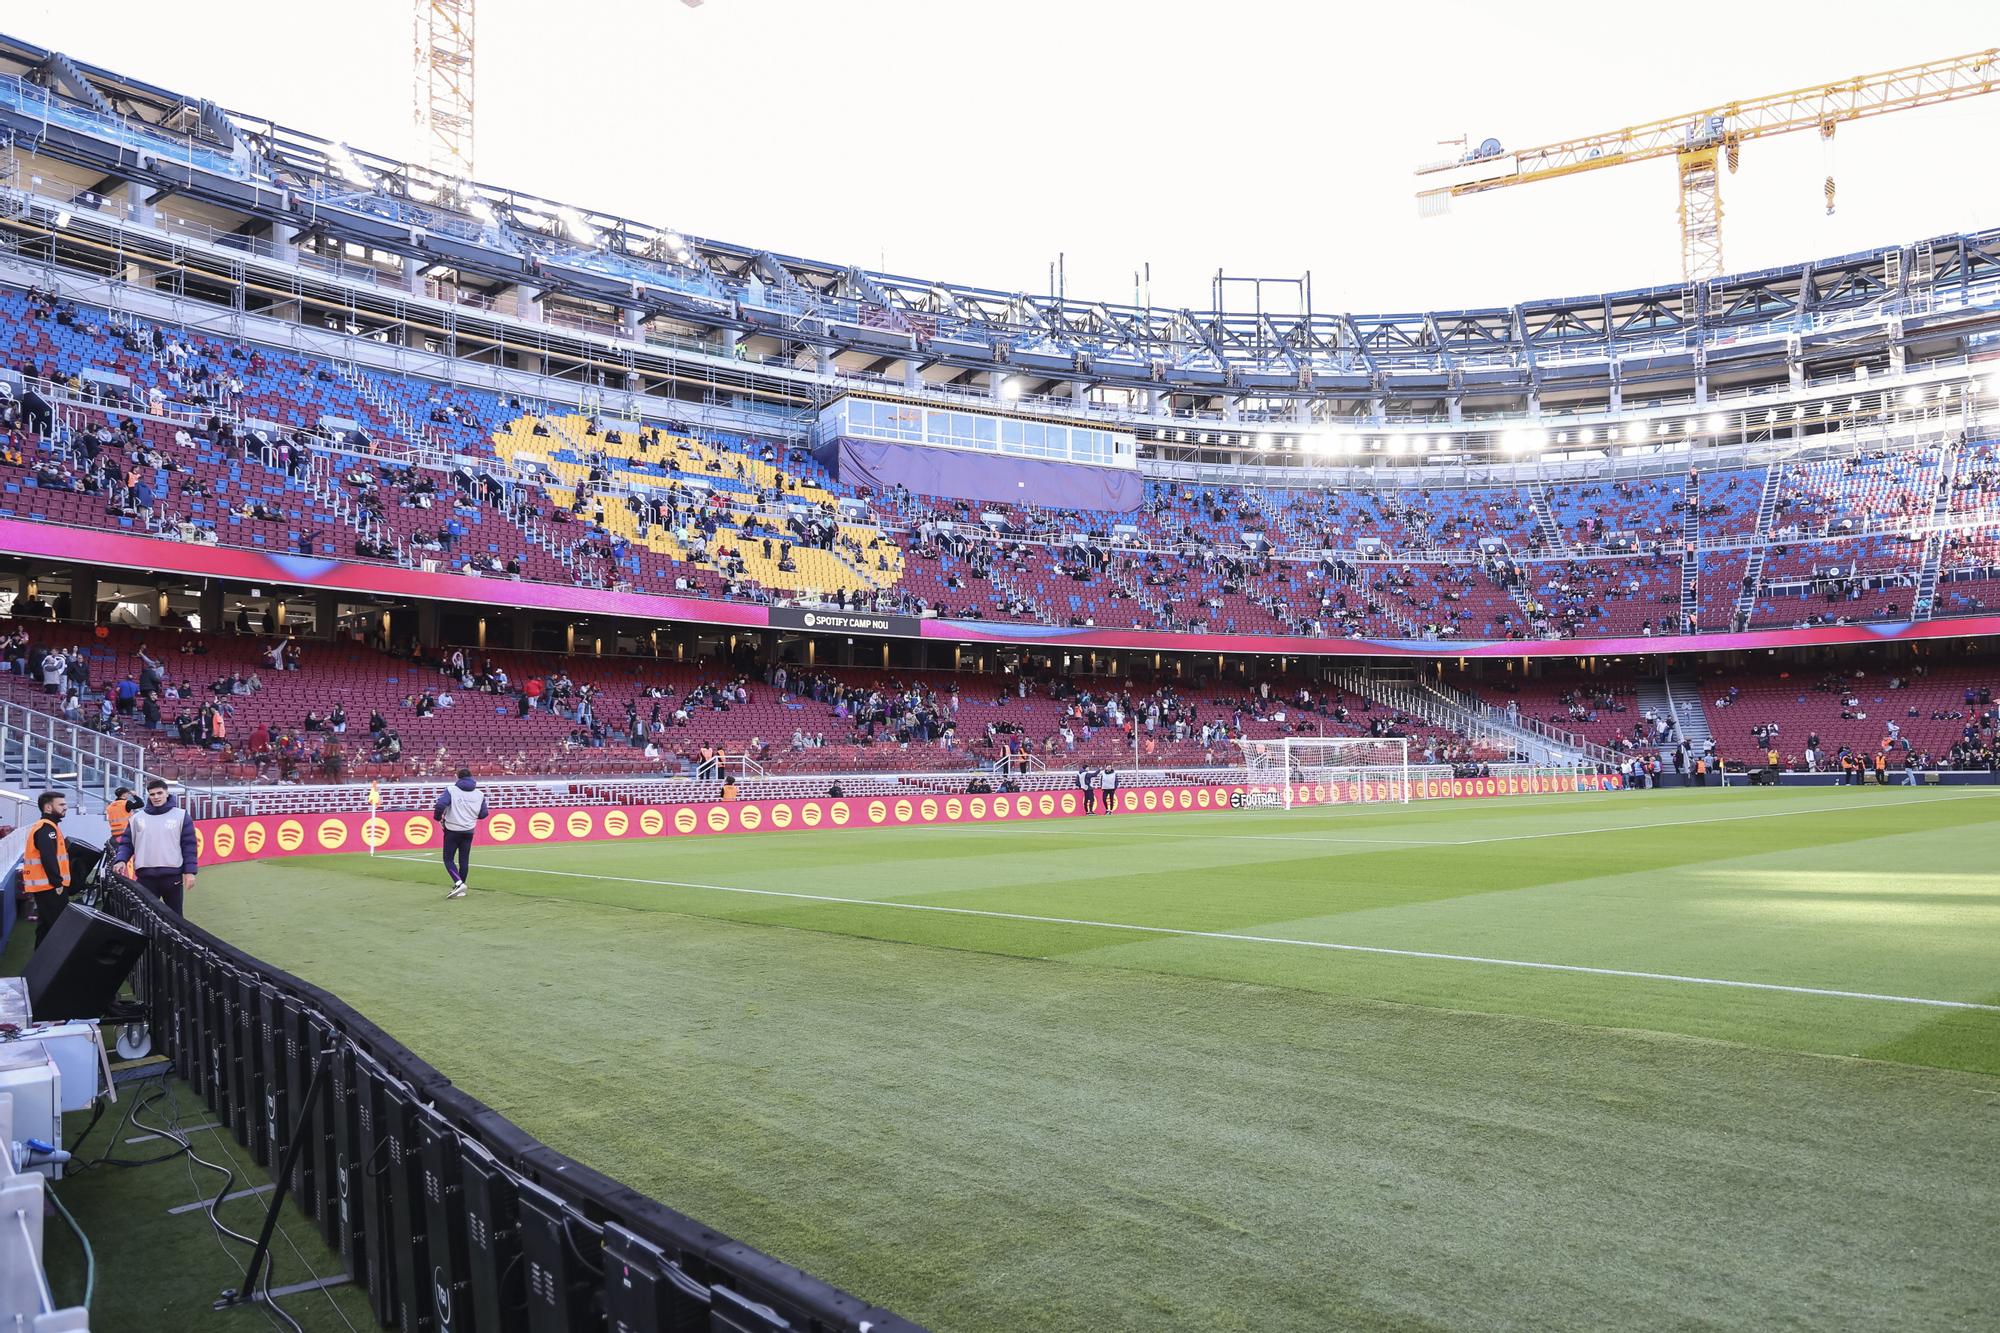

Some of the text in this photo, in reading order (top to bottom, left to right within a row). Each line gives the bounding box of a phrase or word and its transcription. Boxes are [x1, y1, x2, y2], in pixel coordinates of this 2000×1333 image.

[816, 616, 889, 629] SPOTIFY CAMP NOU
